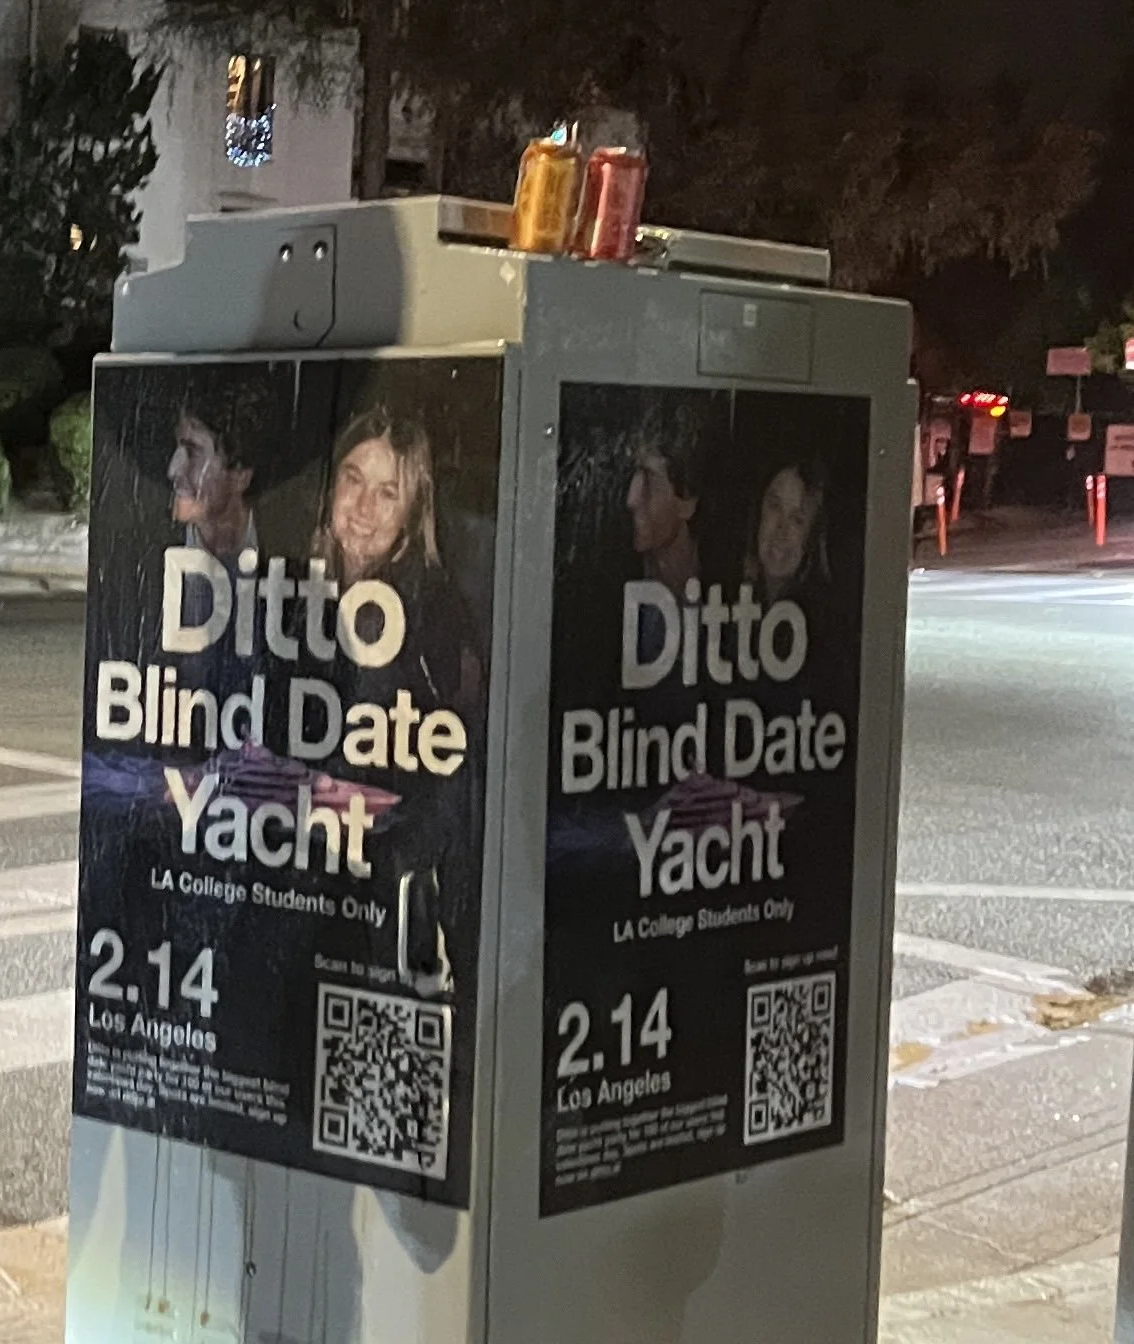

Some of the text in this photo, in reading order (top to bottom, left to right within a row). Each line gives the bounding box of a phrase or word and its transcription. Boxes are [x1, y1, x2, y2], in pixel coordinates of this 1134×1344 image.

[162, 546, 406, 668] Ditto
[621, 577, 809, 690] Ditto
[96, 660, 468, 777] Blind Date
[561, 698, 847, 795] Blind Date
[164, 766, 374, 879] Yacht
[624, 799, 786, 898] Yacht
[151, 867, 387, 929] LA College Students Only
[613, 896, 794, 944] LA College Students Only
[88, 927, 219, 1018] 2.14
[89, 1001, 217, 1053] Los Angeles
[557, 986, 672, 1078] 2.14
[557, 1068, 671, 1113] Los Angeles
